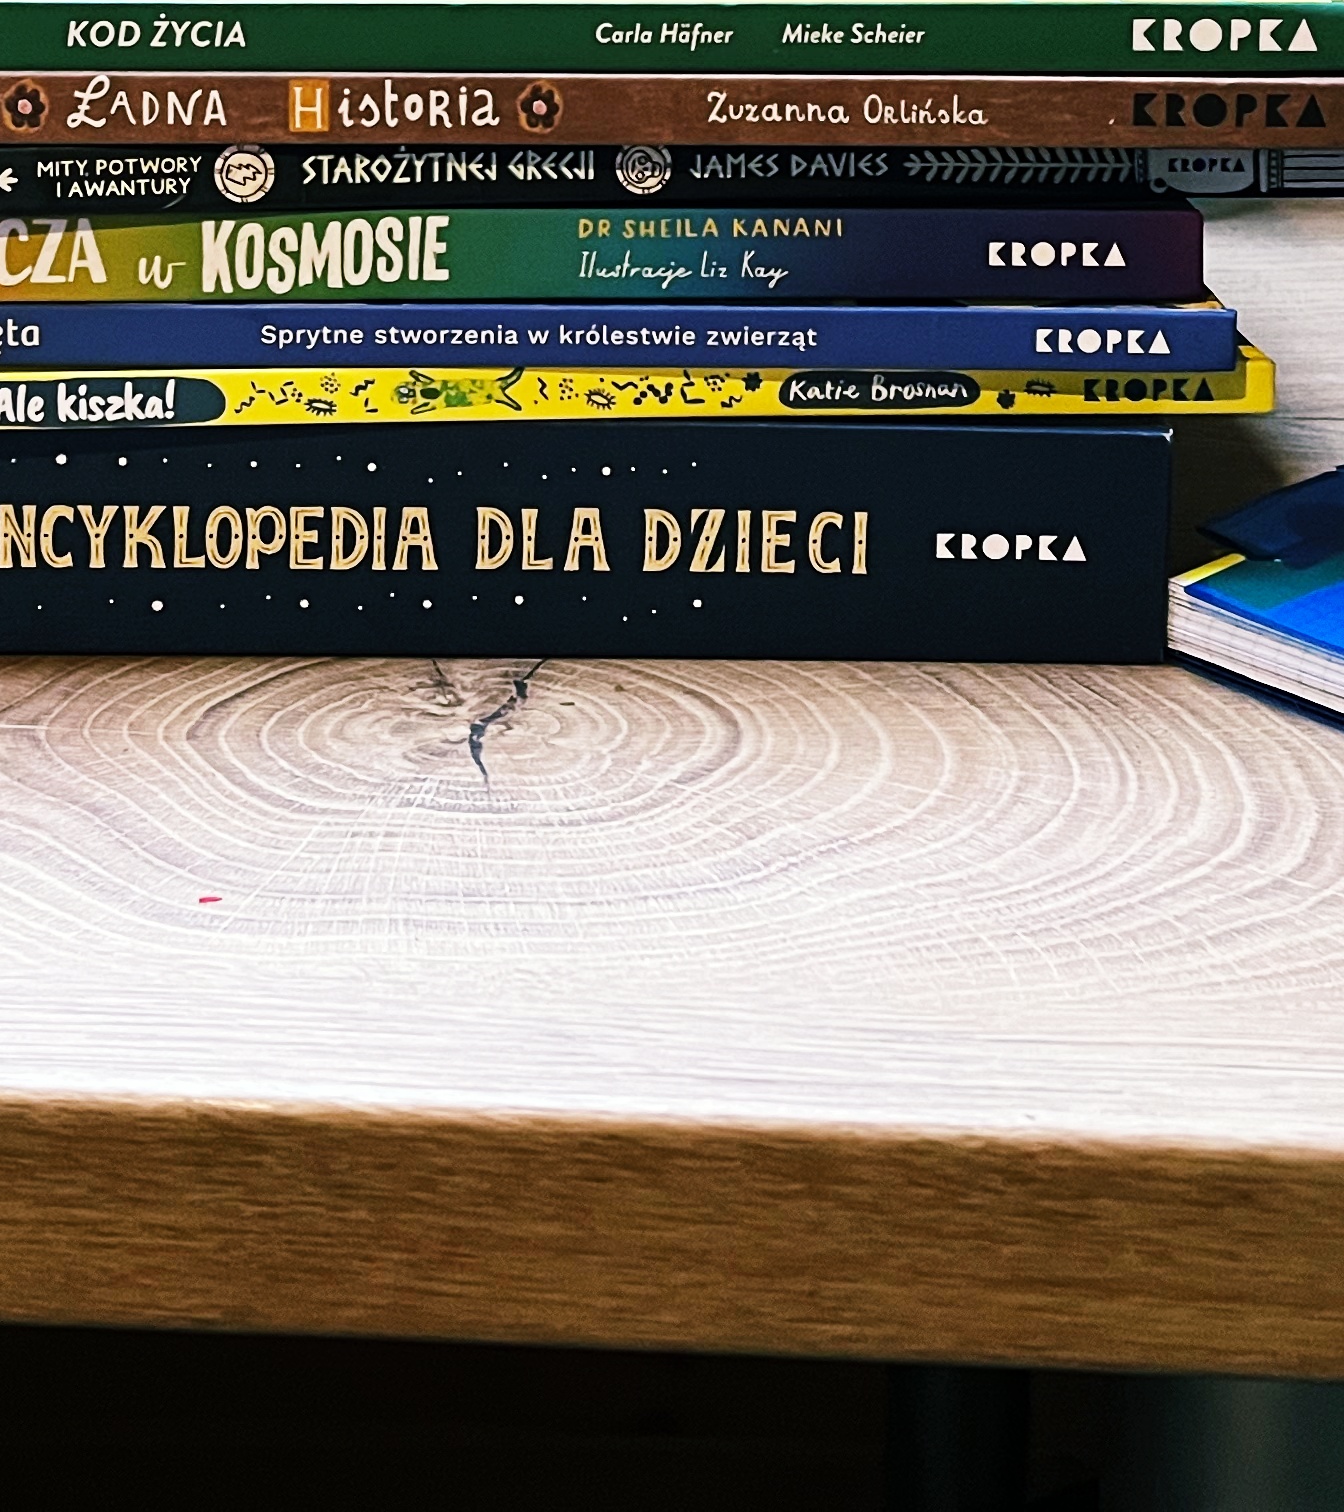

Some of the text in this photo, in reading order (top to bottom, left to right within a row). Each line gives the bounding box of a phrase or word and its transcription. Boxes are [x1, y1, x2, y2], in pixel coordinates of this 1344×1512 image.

[67, 12, 246, 48] KOD ŻYCIA
[595, 22, 734, 52] Carla Häfner
[781, 22, 926, 44] Mieke Scheier
[1132, 18, 1318, 52] KROPKA
[707, 91, 850, 124] Zuzanna
[1132, 92, 1327, 129] KROPKA
[95, 155, 203, 176] POTWORY
[301, 145, 498, 185] STAROŻYTNEJ
[689, 152, 889, 179] JAMES DAVIES
[1167, 157, 1246, 173] KROPKA
[67, 177, 191, 198] AWANTURY
[578, 217, 842, 239] DR SHEILA KANANI
[201, 215, 452, 295] KOSMOSIE
[988, 241, 1126, 267] KROPKA
[700, 250, 728, 278] Liz
[741, 250, 789, 289] Kay
[260, 323, 818, 352] Sprytne stworzenia w królestwie zwierząt
[1035, 328, 1171, 354] KROPKA
[56, 378, 177, 421] kiszka!
[789, 379, 860, 402] Katie
[1083, 377, 1216, 402] KROPKA
[474, 506, 611, 572] DLA
[642, 508, 869, 575] DZIECI
[935, 533, 1087, 562] KROPKA
